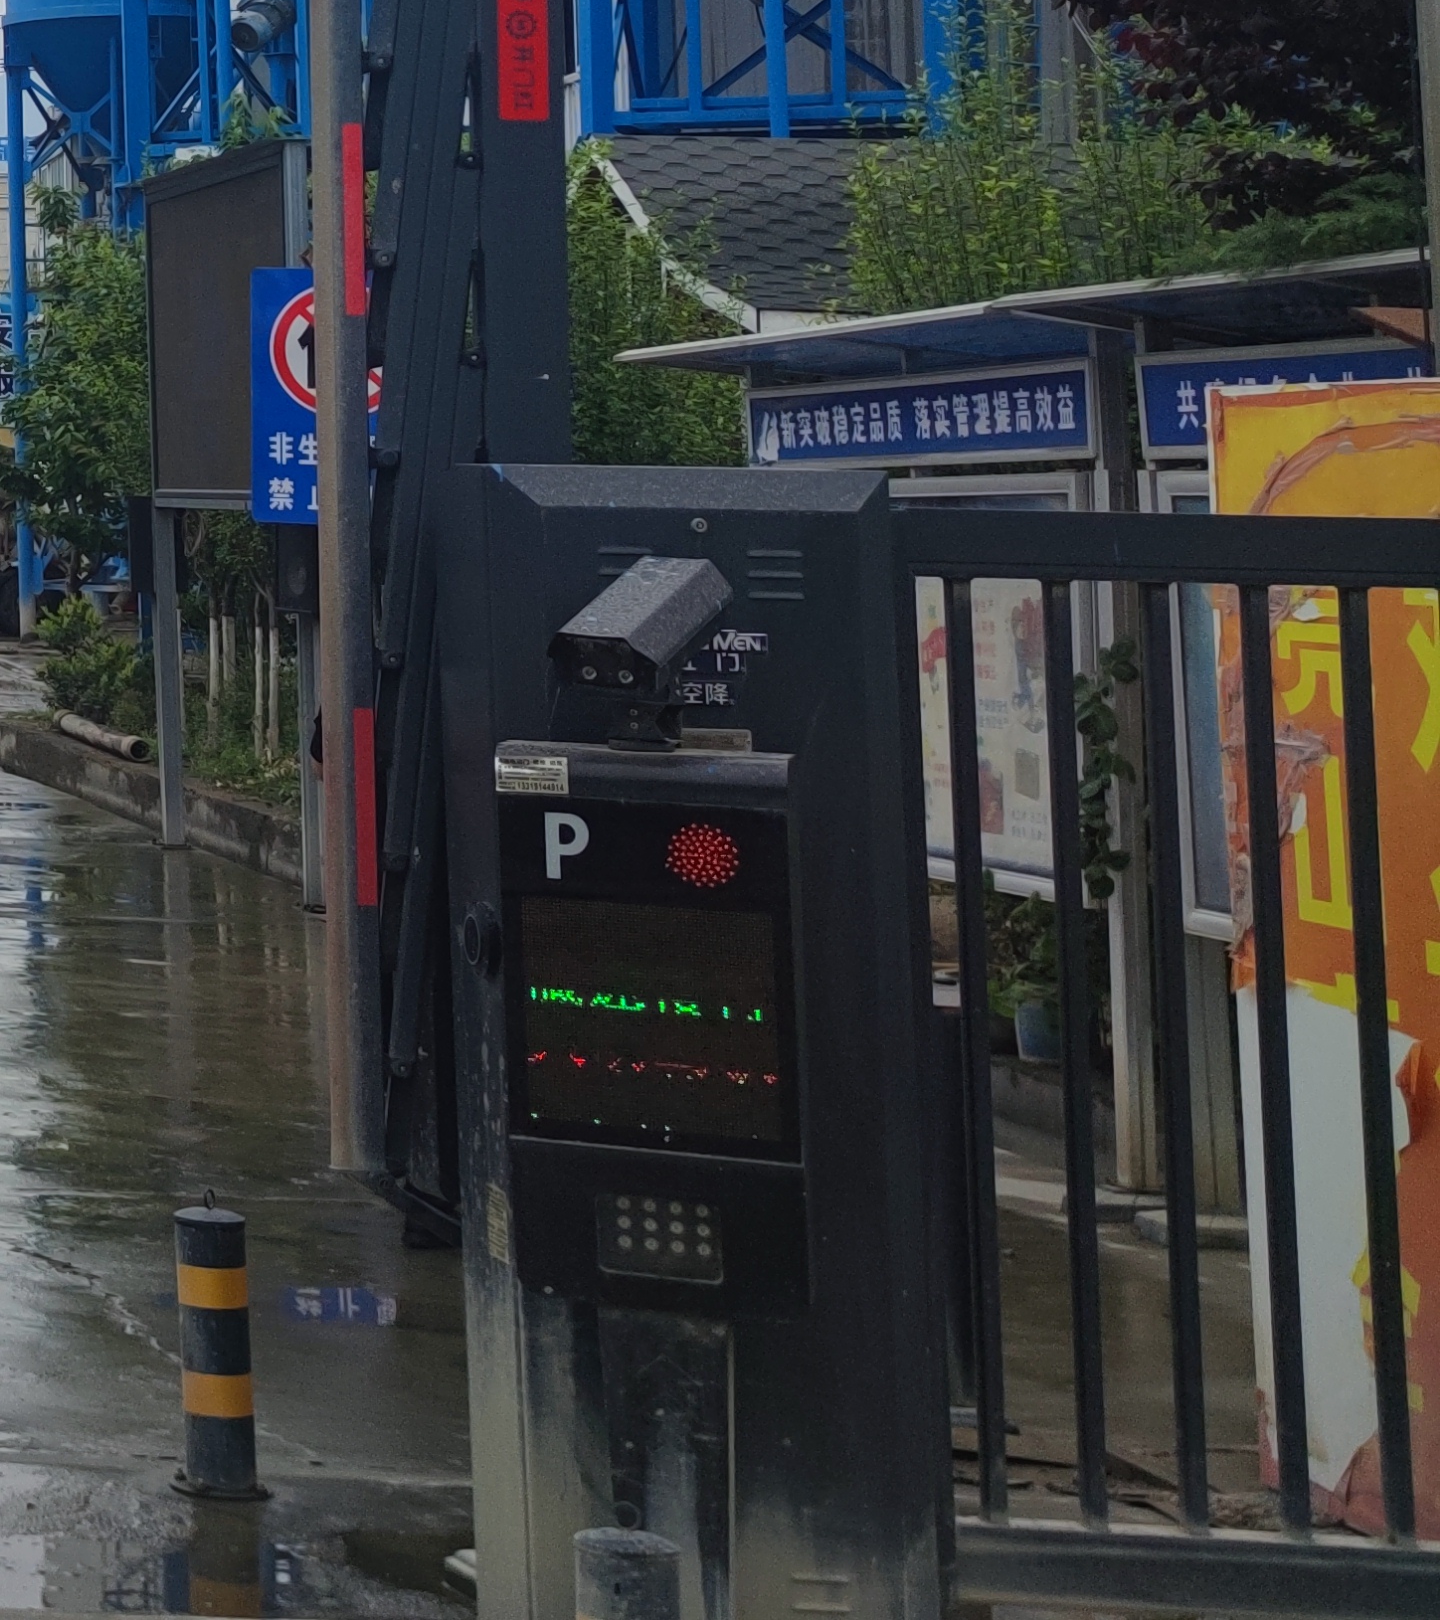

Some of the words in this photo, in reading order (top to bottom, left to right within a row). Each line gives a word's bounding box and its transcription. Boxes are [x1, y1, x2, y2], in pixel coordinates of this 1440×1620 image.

[758, 399, 903, 452] 新突破稳定品质
[913, 384, 1076, 440] 落实管理提高效益
[544, 811, 590, 879] P
